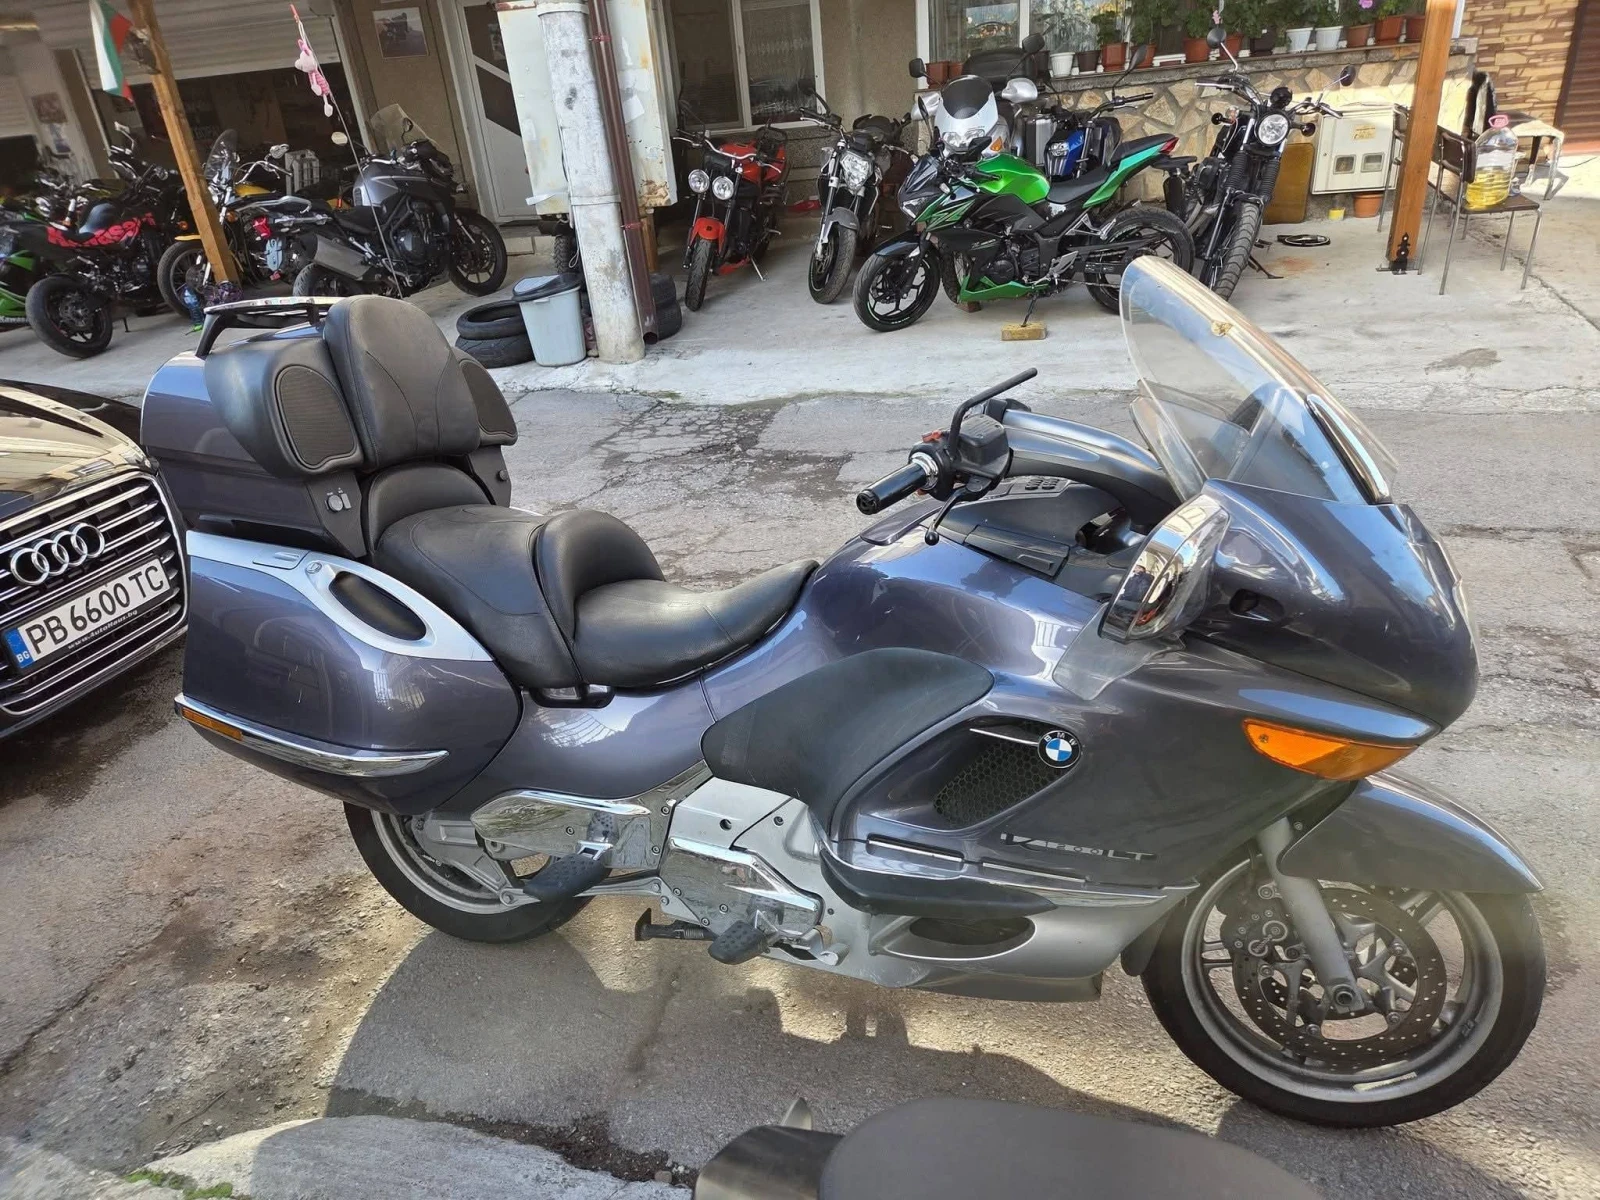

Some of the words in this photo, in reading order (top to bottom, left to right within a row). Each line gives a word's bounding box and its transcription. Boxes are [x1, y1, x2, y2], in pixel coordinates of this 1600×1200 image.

[25, 615, 69, 654] PB
[69, 583, 130, 632] 6600
[128, 565, 164, 598] TC
[16, 650, 30, 663] BG
[1043, 732, 1078, 746] BMW
